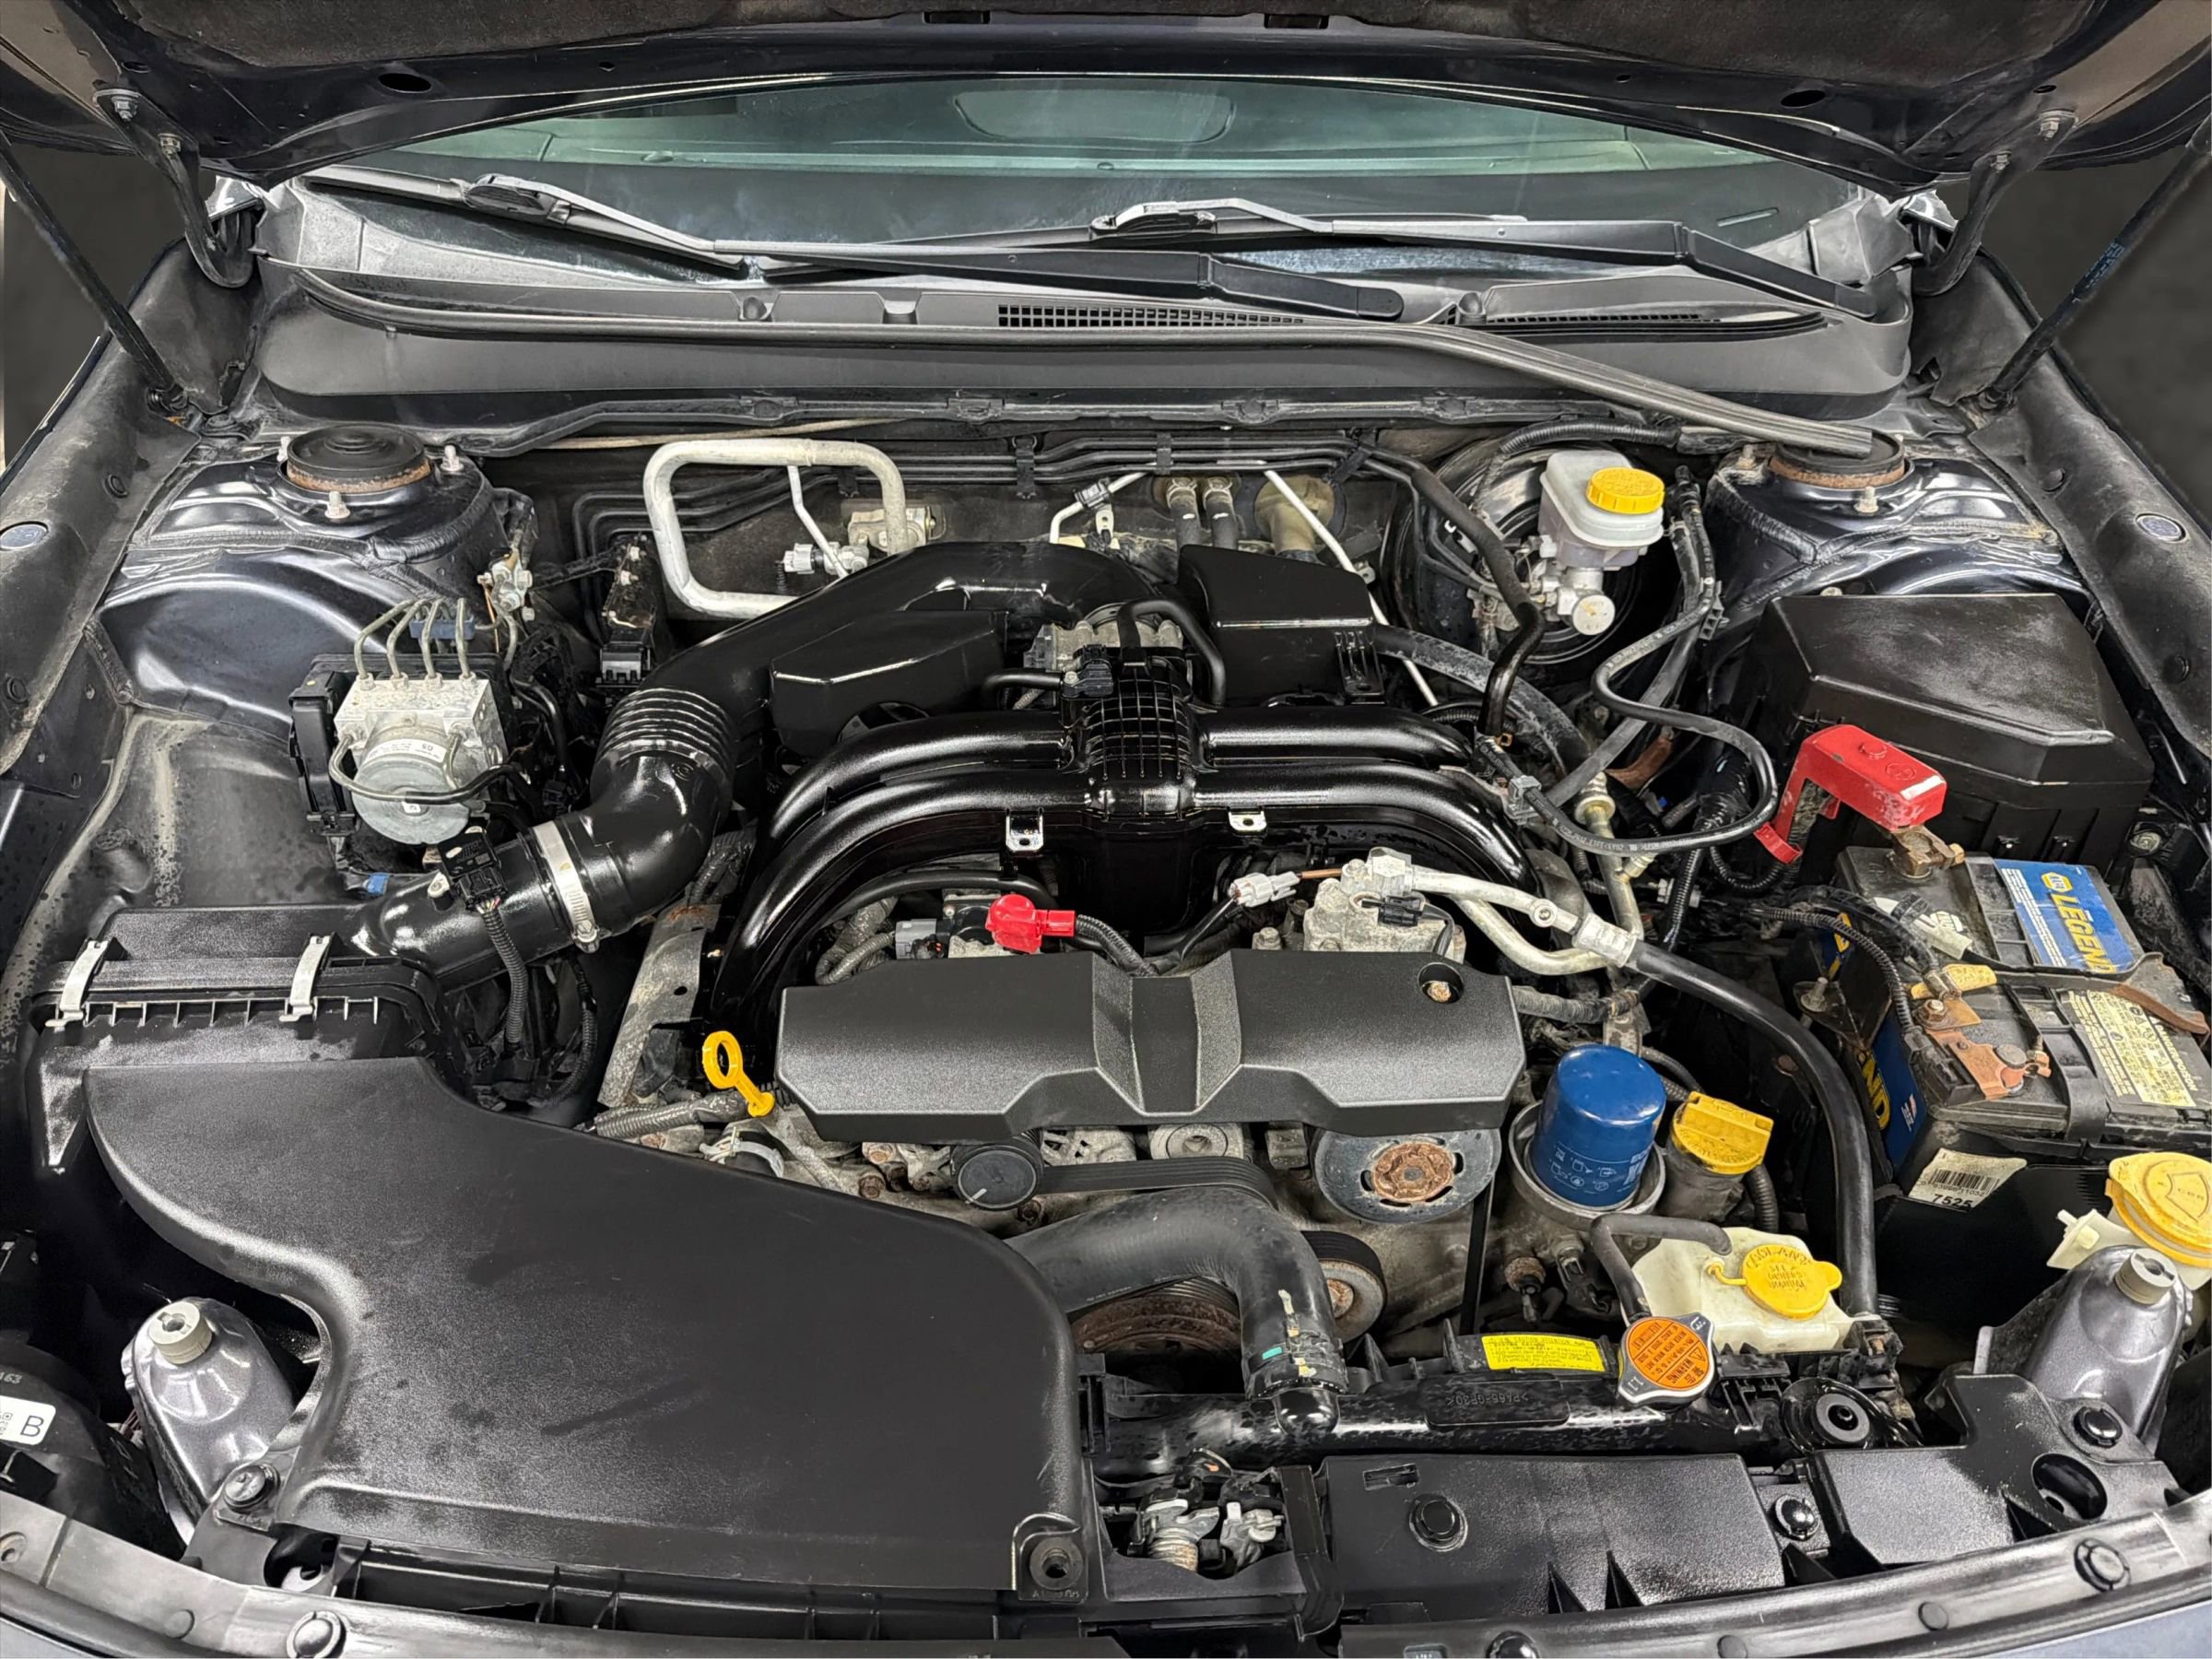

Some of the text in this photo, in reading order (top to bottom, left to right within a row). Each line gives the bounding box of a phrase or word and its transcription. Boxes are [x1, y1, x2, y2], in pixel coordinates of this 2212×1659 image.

[1932, 1194, 1974, 1208] 7525
[1665, 1358, 1694, 1384] WARNING
[19, 1415, 44, 1437] B
